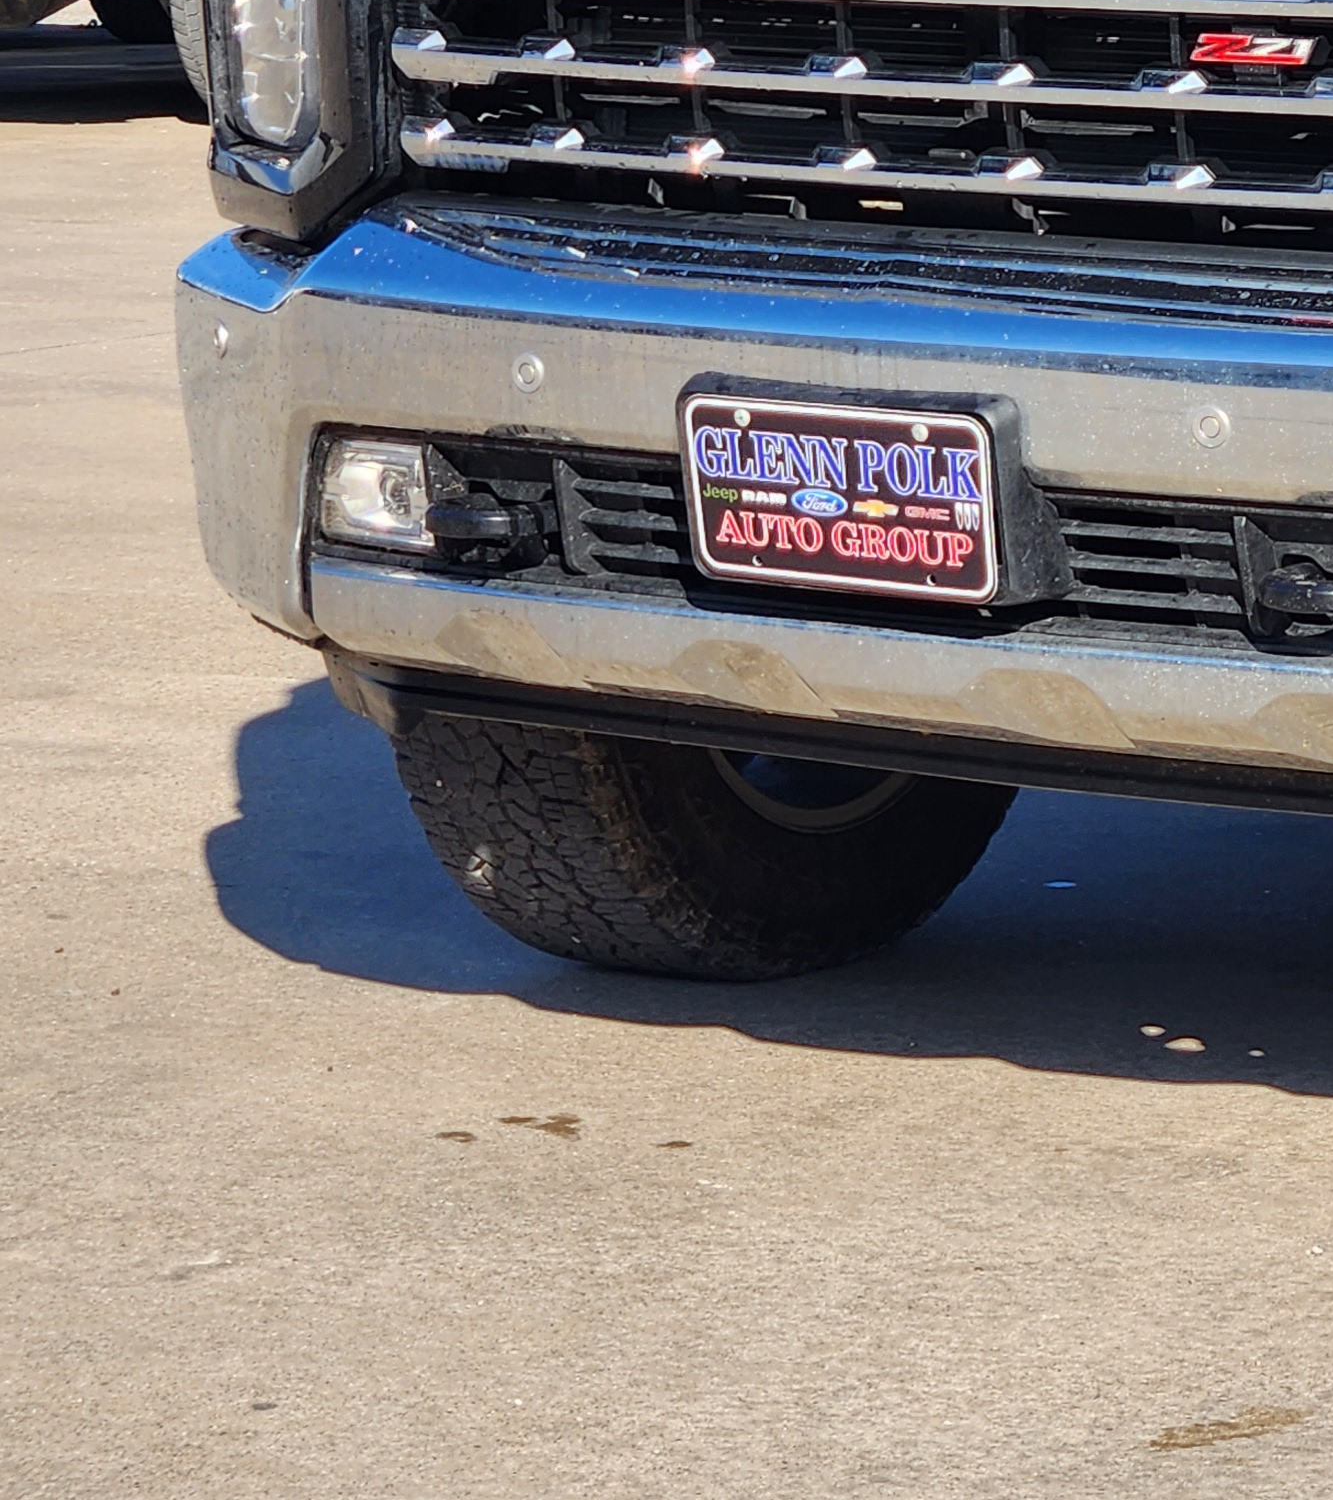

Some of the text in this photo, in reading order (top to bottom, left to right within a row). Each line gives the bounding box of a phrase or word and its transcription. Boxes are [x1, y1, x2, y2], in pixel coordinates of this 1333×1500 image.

[1189, 33, 1317, 65] Z71
[694, 426, 983, 500] GLENN POLK
[702, 483, 738, 503] Jeep
[904, 506, 951, 521] GMC
[715, 510, 974, 567] AUTO GROUP
